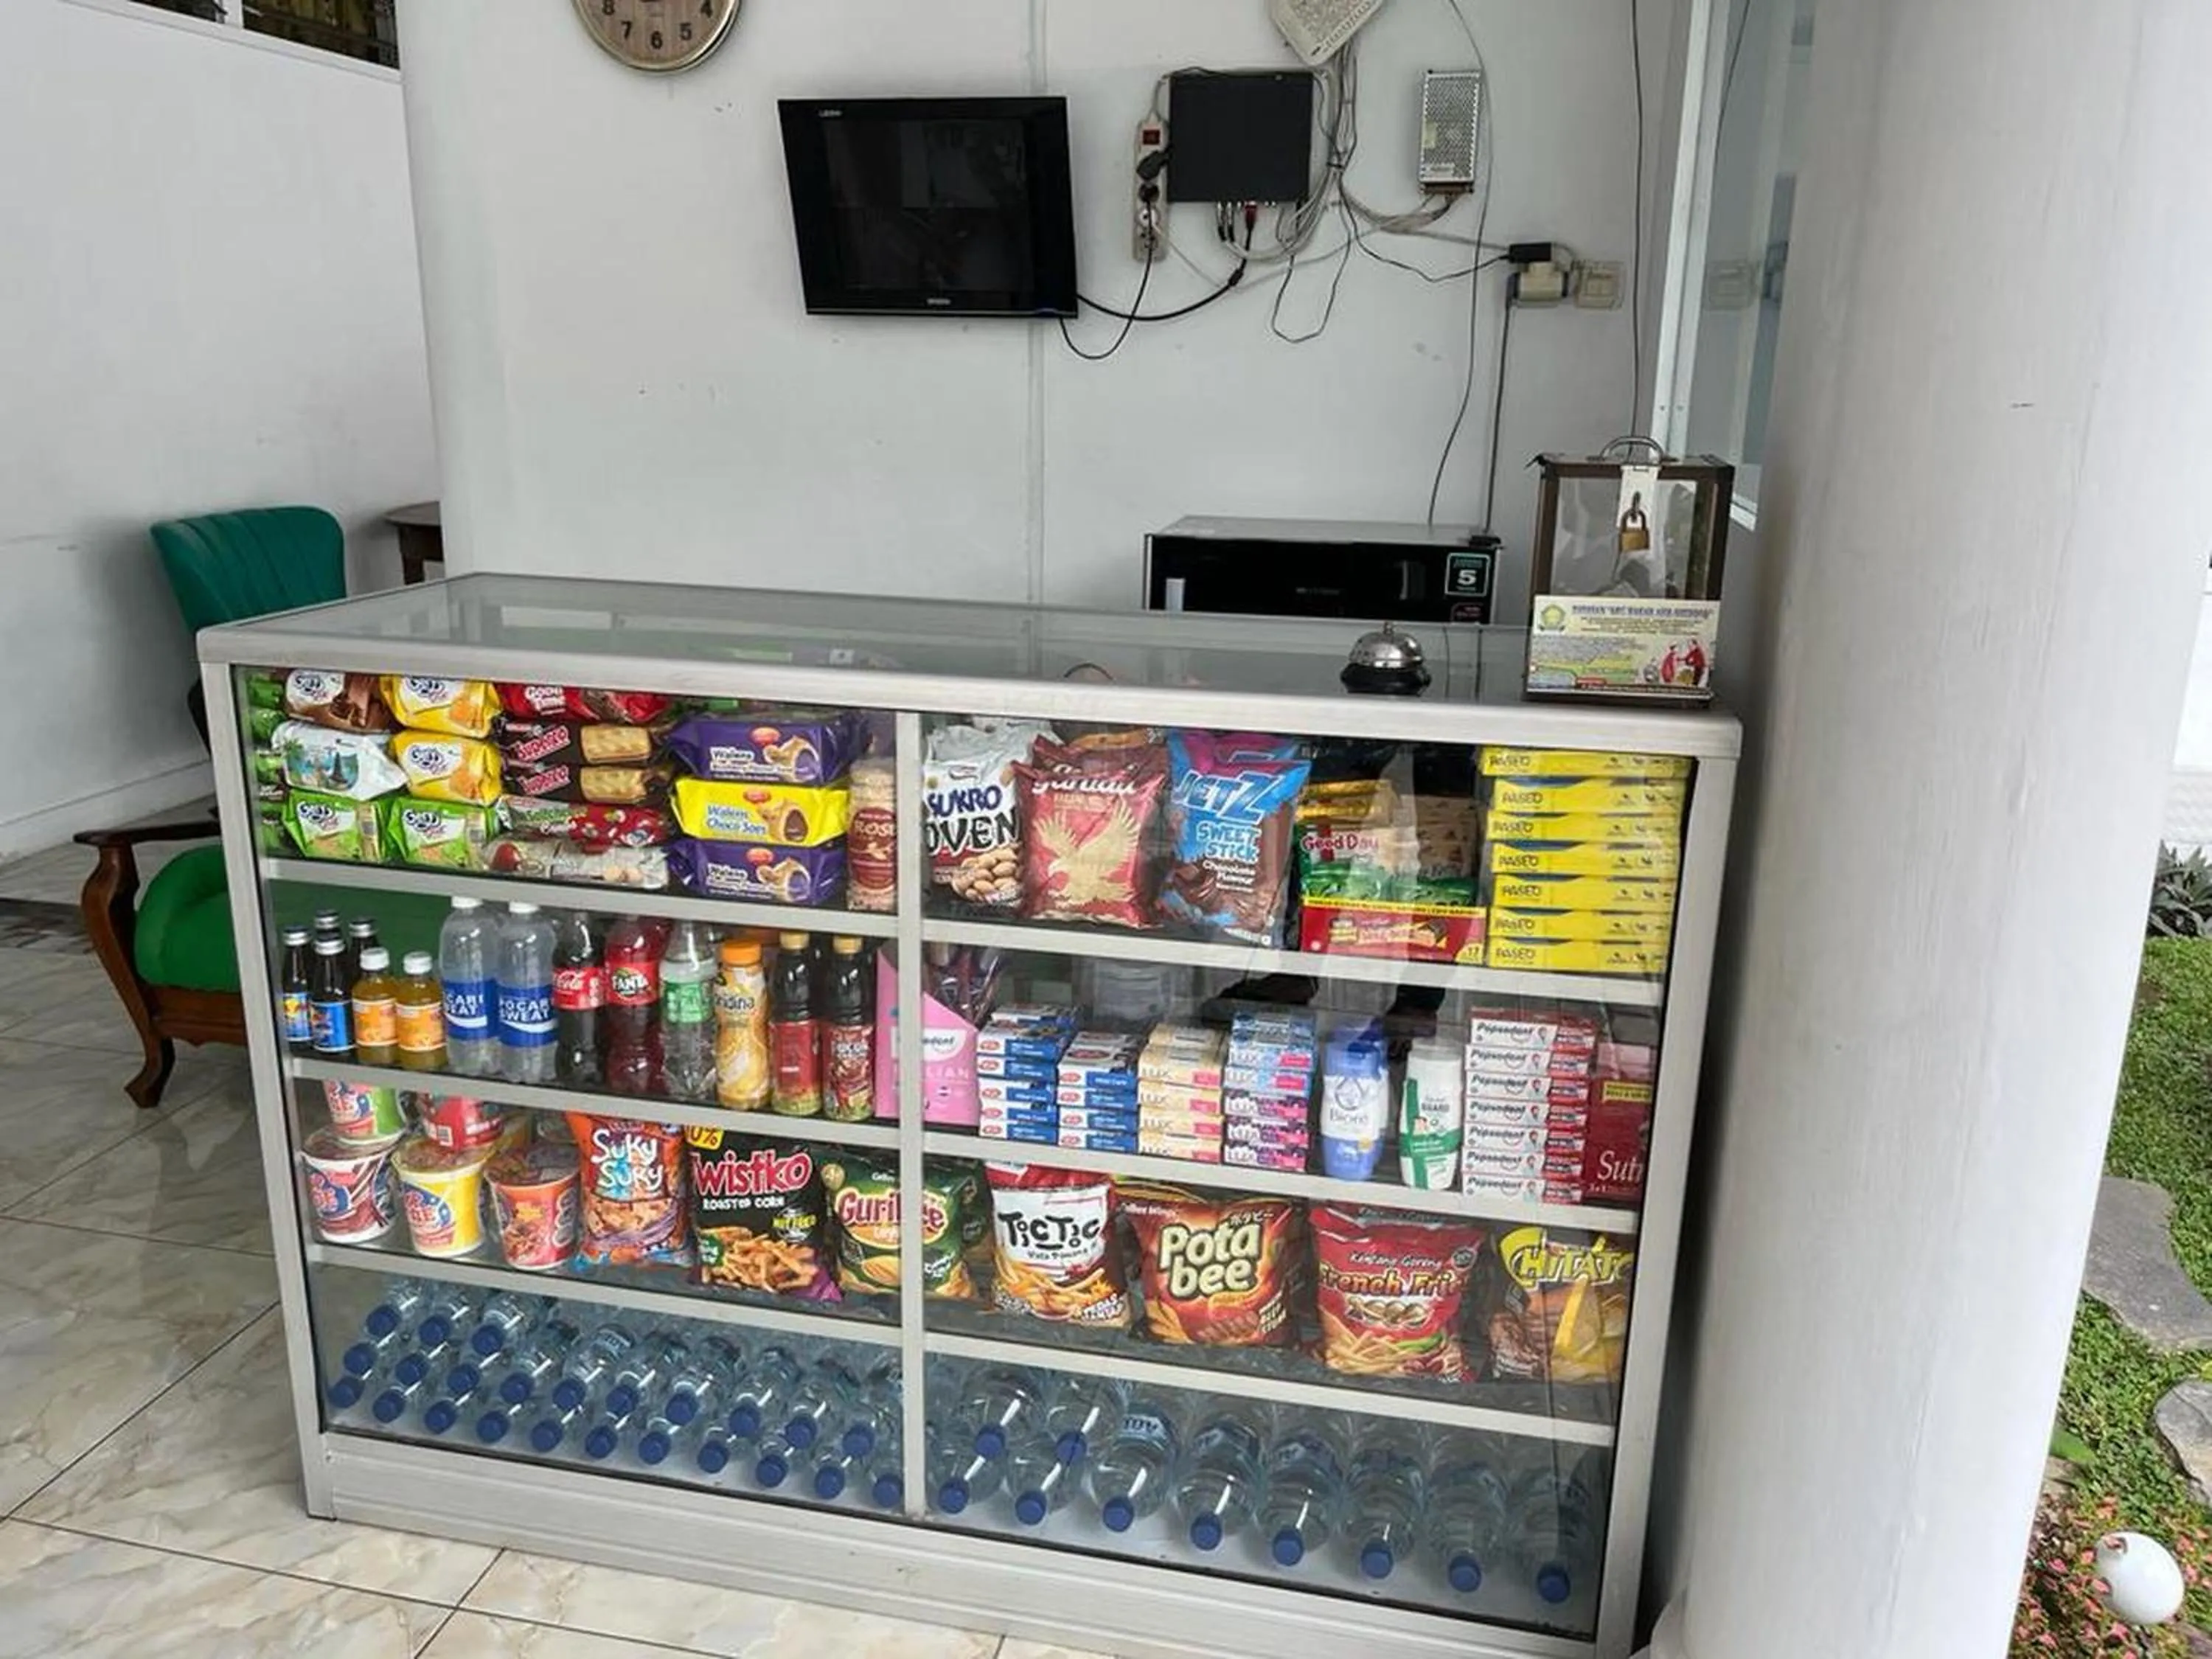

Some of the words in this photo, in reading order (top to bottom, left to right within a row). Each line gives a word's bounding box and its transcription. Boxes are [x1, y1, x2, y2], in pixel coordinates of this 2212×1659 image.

[621, 21, 632, 39] 7
[650, 32, 663, 49] 6
[680, 23, 692, 41] 5
[1457, 569, 1477, 585] 5
[927, 785, 1002, 817] SUKRO
[1172, 769, 1284, 824] JETZ
[1196, 822, 1262, 844] SWEET
[1160, 1224, 1261, 1270] Pota
[1170, 1256, 1253, 1299] bee
